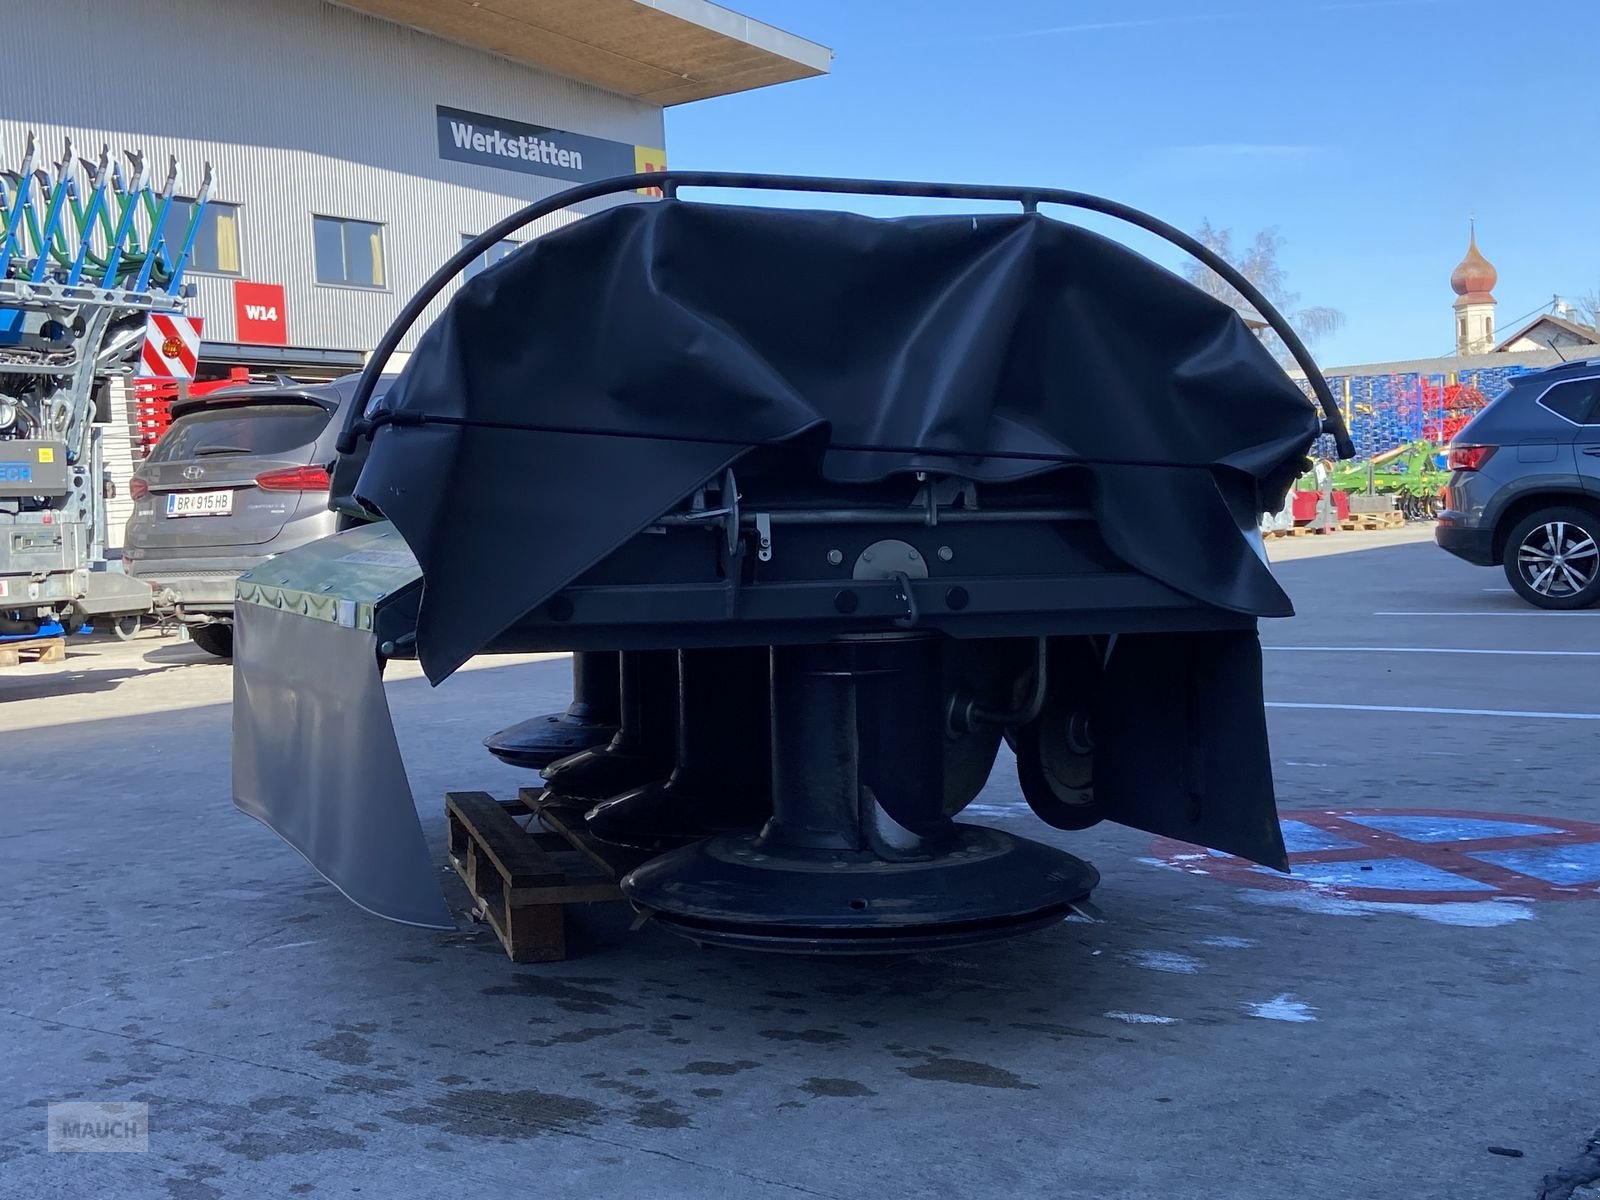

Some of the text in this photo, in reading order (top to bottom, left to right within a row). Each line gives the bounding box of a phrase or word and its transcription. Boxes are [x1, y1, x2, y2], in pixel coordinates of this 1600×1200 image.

[450, 121, 583, 170] Werkstätten
[245, 304, 278, 321] W14
[177, 494, 228, 510] BR 915 HB
